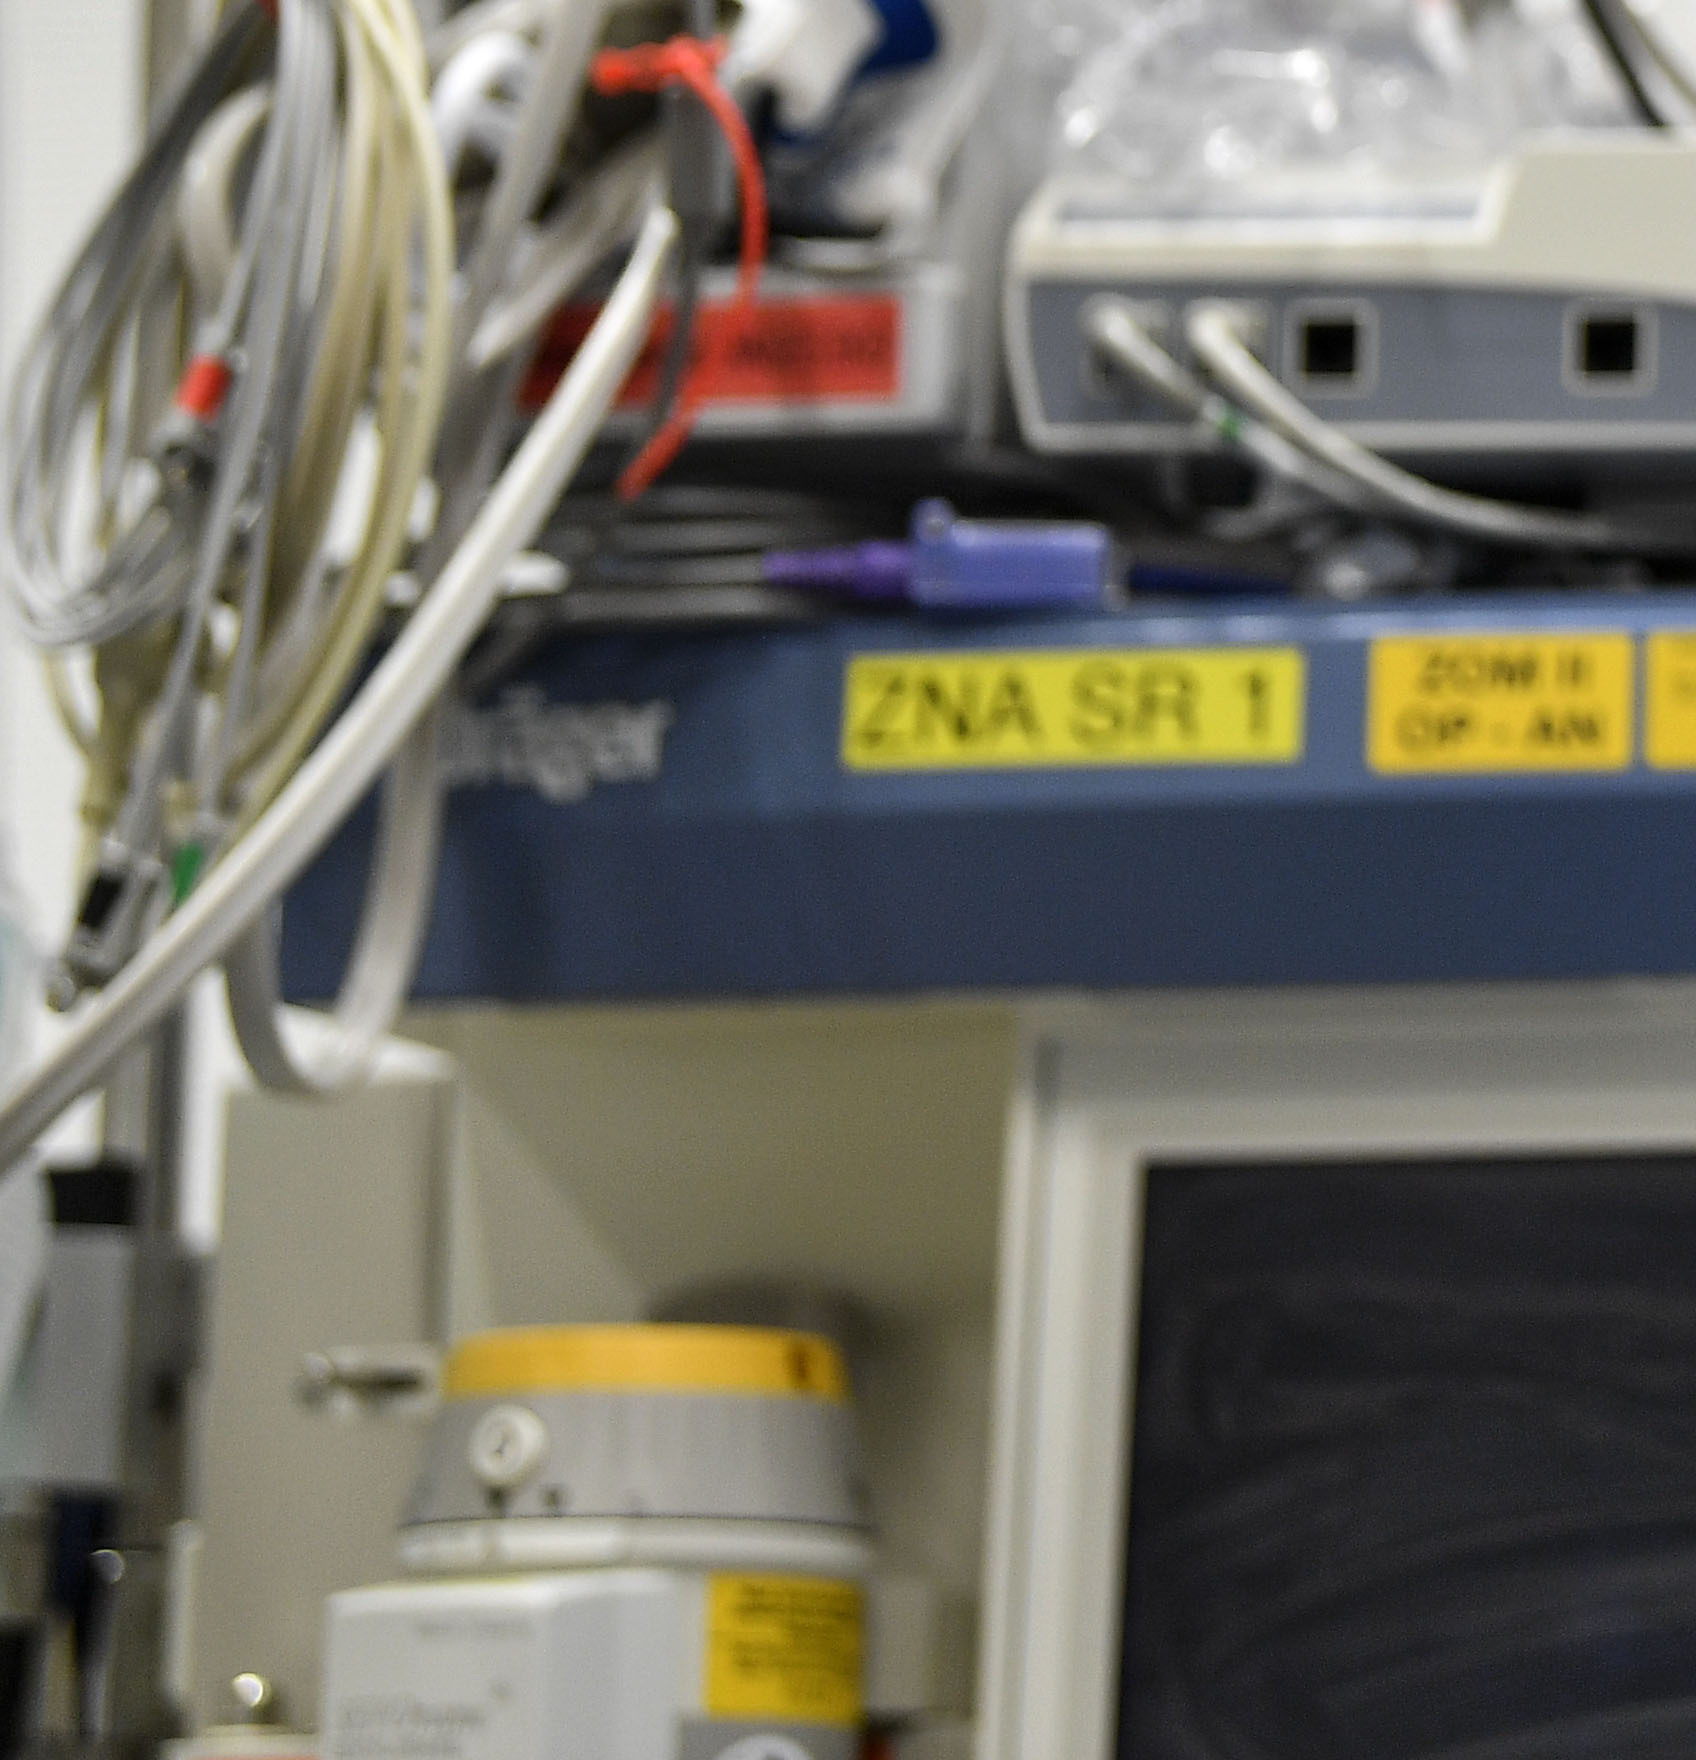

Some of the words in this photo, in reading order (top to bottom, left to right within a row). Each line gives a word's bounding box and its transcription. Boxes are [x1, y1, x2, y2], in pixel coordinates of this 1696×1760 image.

[854, 663, 1045, 750] ZNA
[1068, 659, 1200, 746] SR
[1238, 665, 1275, 736] 1
